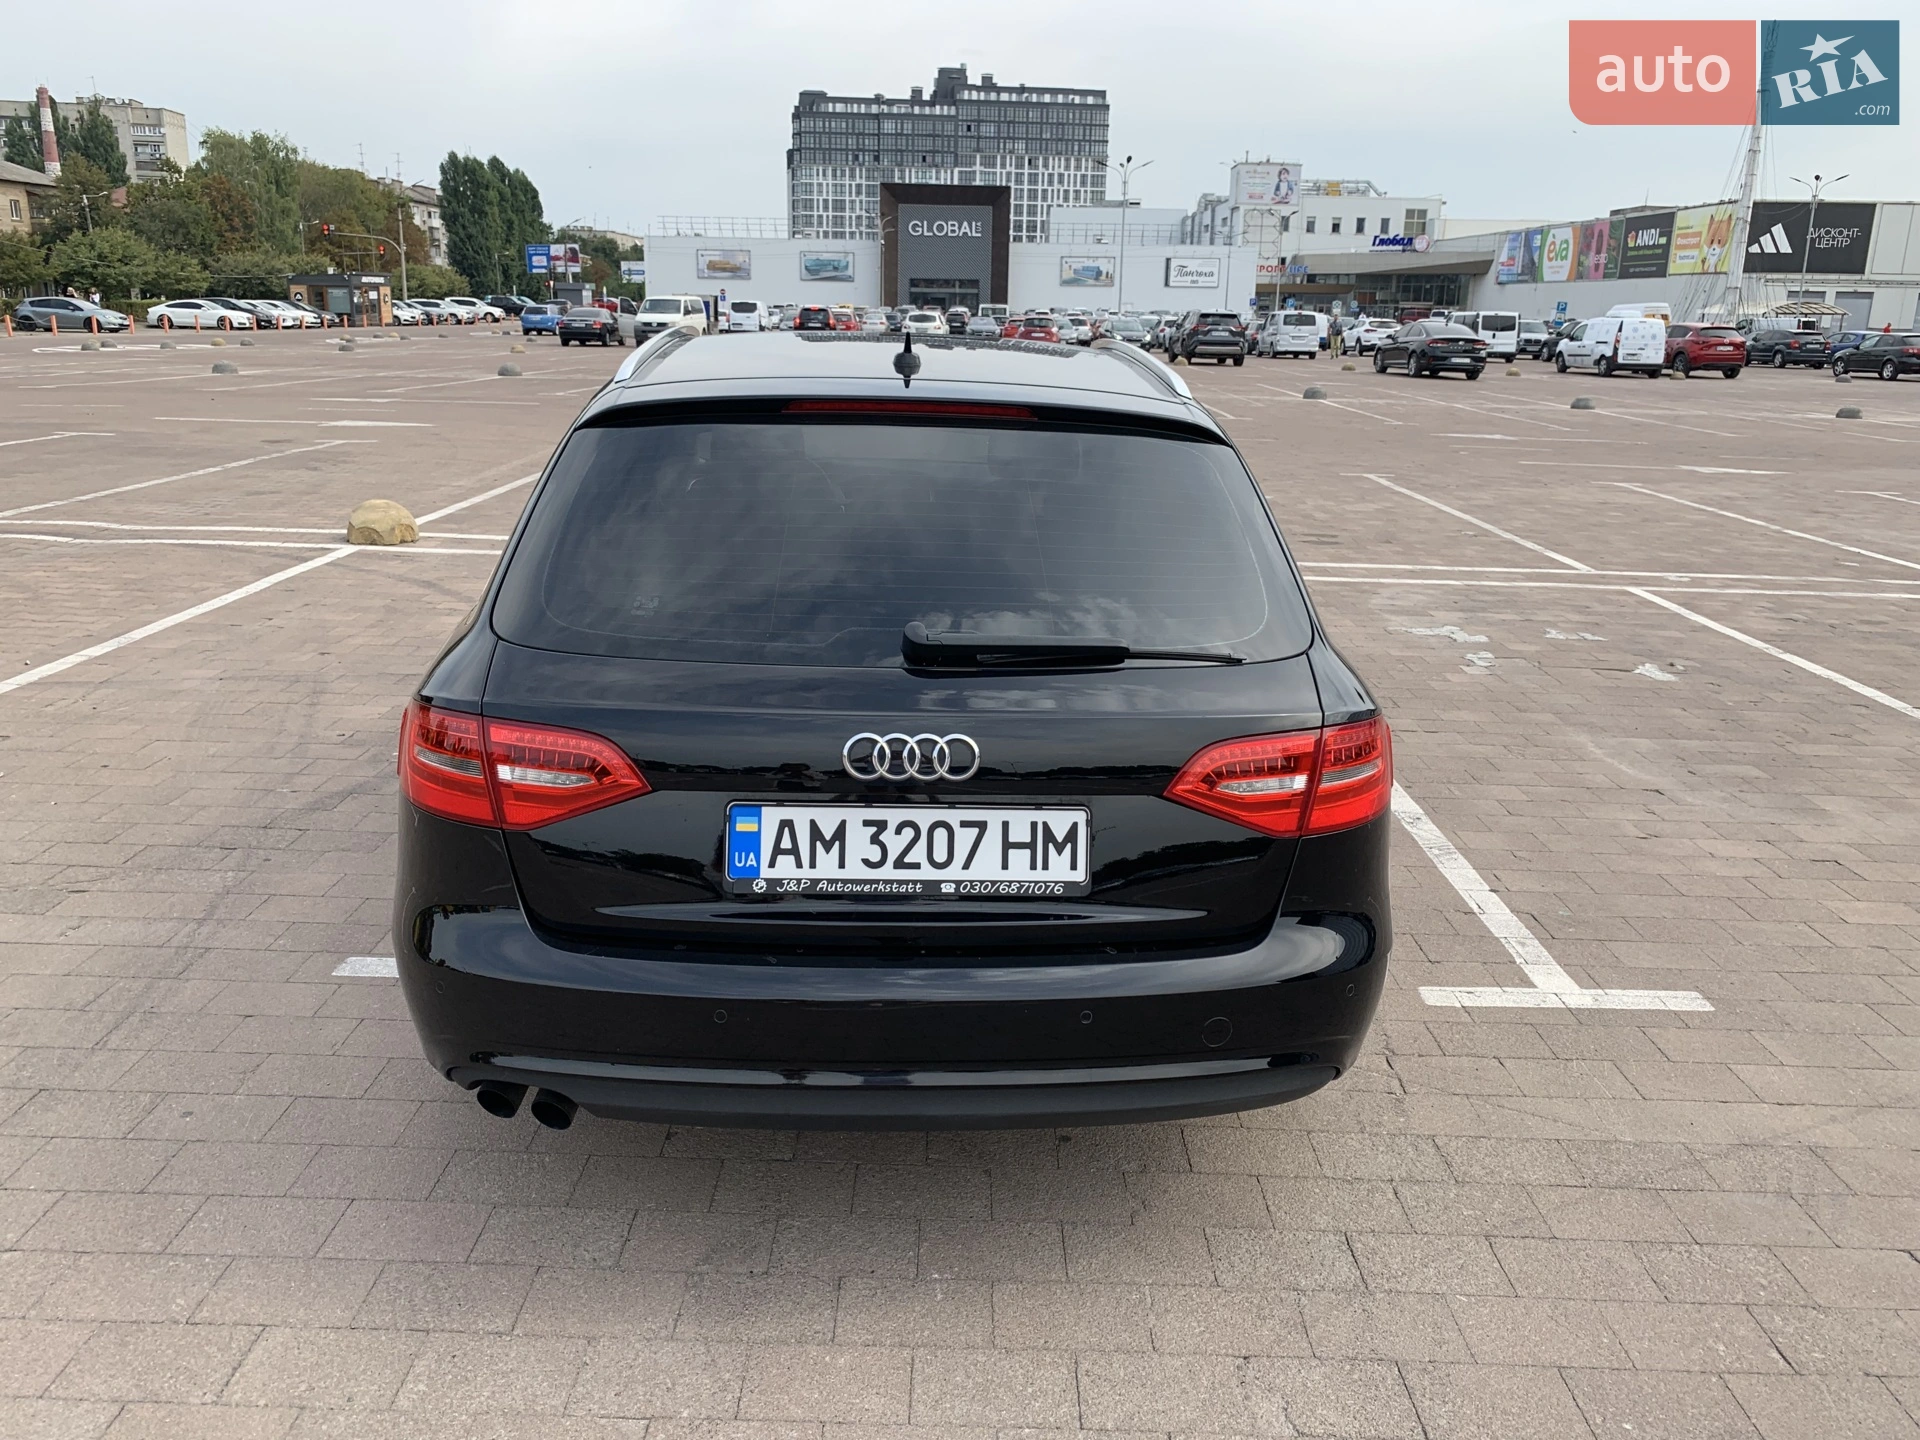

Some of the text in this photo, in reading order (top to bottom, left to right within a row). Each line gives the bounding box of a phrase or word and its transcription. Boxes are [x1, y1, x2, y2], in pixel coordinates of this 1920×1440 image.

[908, 220, 982, 237] GLOBAL
[1806, 227, 1862, 239] ДИСКОНТ-
[1371, 233, 1414, 247] Глобал
[1636, 228, 1660, 247] ANDI
[1815, 238, 1851, 249] ЦЕНТР
[1174, 264, 1215, 279] Панчоха
[767, 819, 1078, 871] AM 3207 HM
[735, 851, 757, 868] UA
[776, 879, 1065, 895] J&P Autowerkstatt 030/6871076
